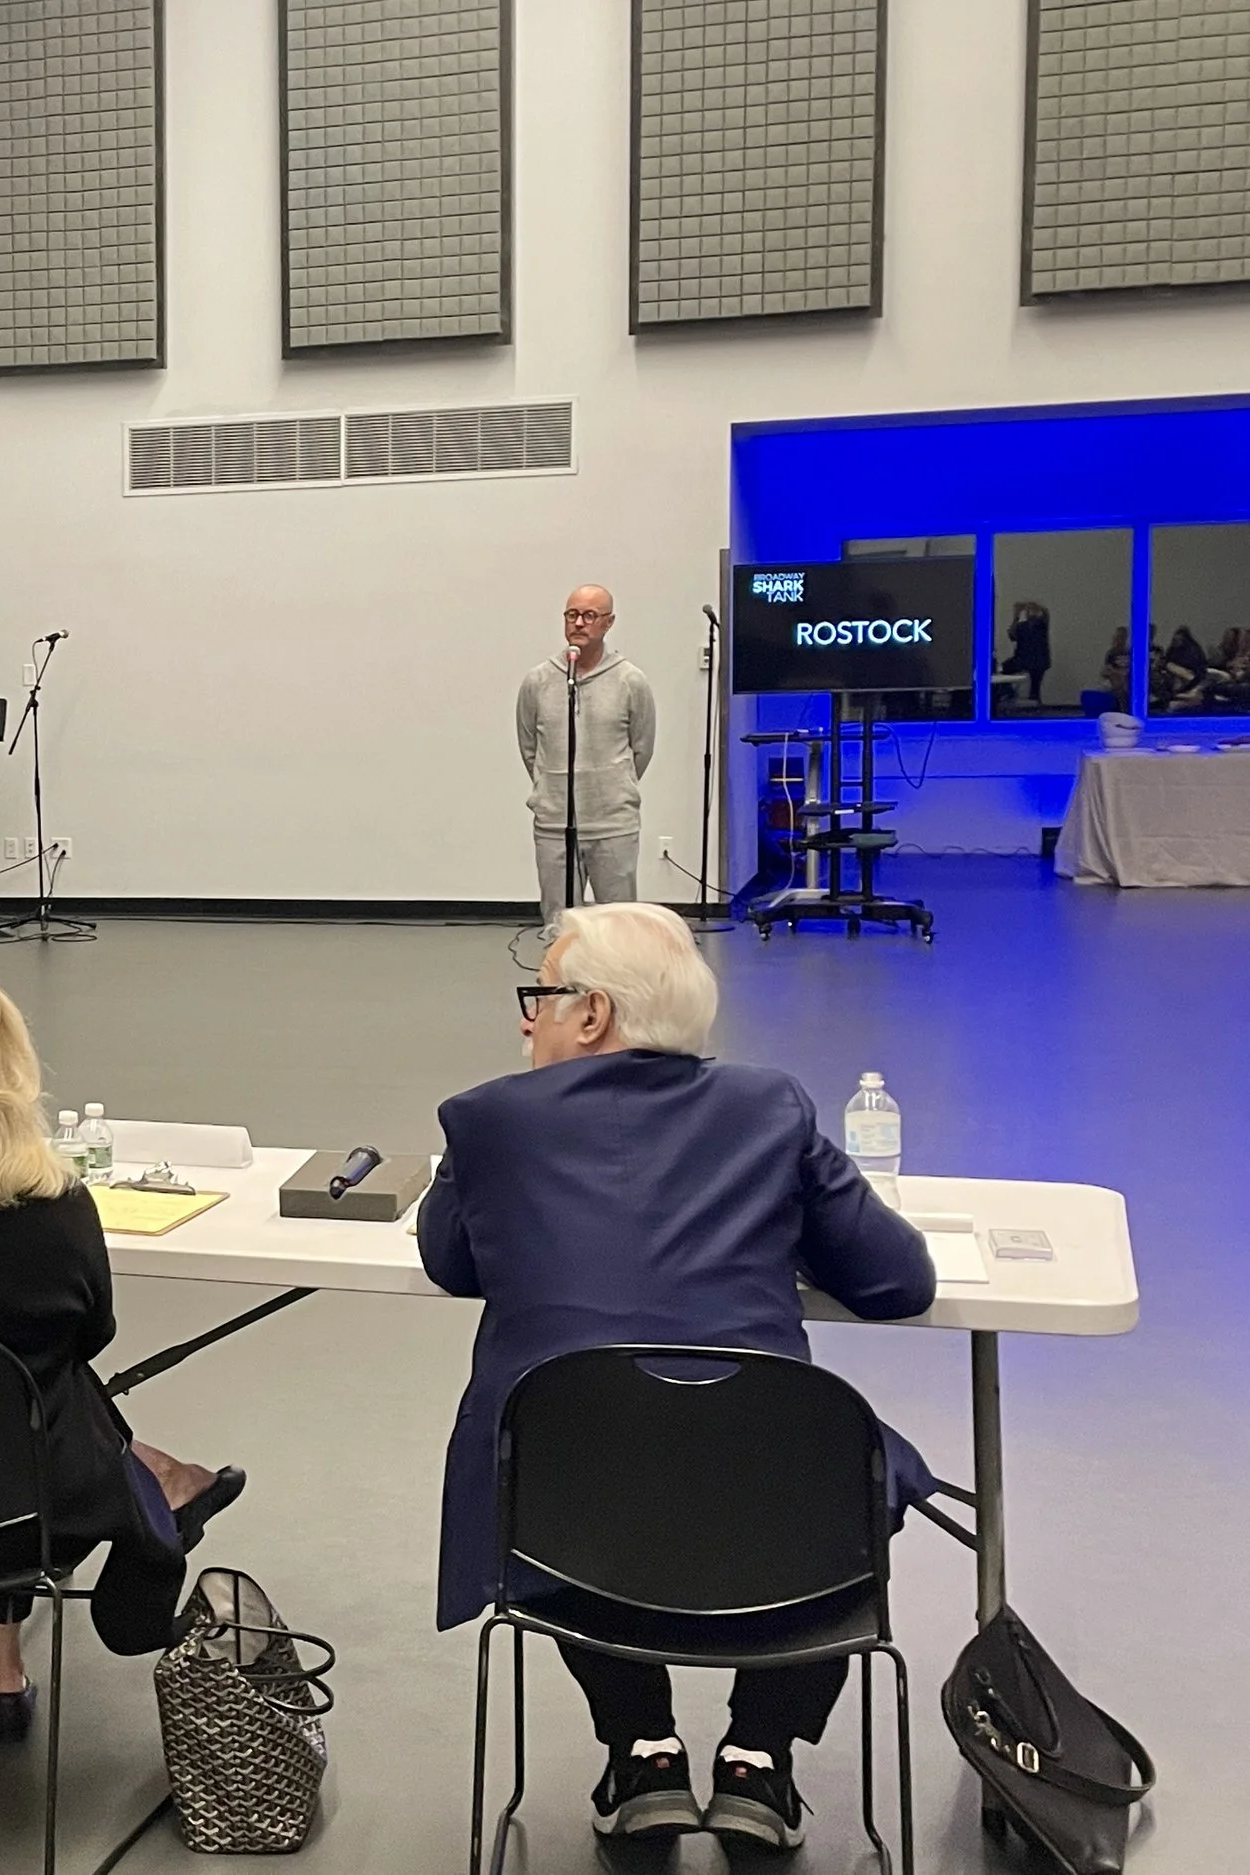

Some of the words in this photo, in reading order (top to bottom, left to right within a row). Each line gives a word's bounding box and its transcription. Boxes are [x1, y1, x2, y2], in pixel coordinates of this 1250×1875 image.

[752, 580, 804, 593] SHARK
[766, 591, 804, 602] TANK
[797, 619, 932, 645] ROSTOCK
